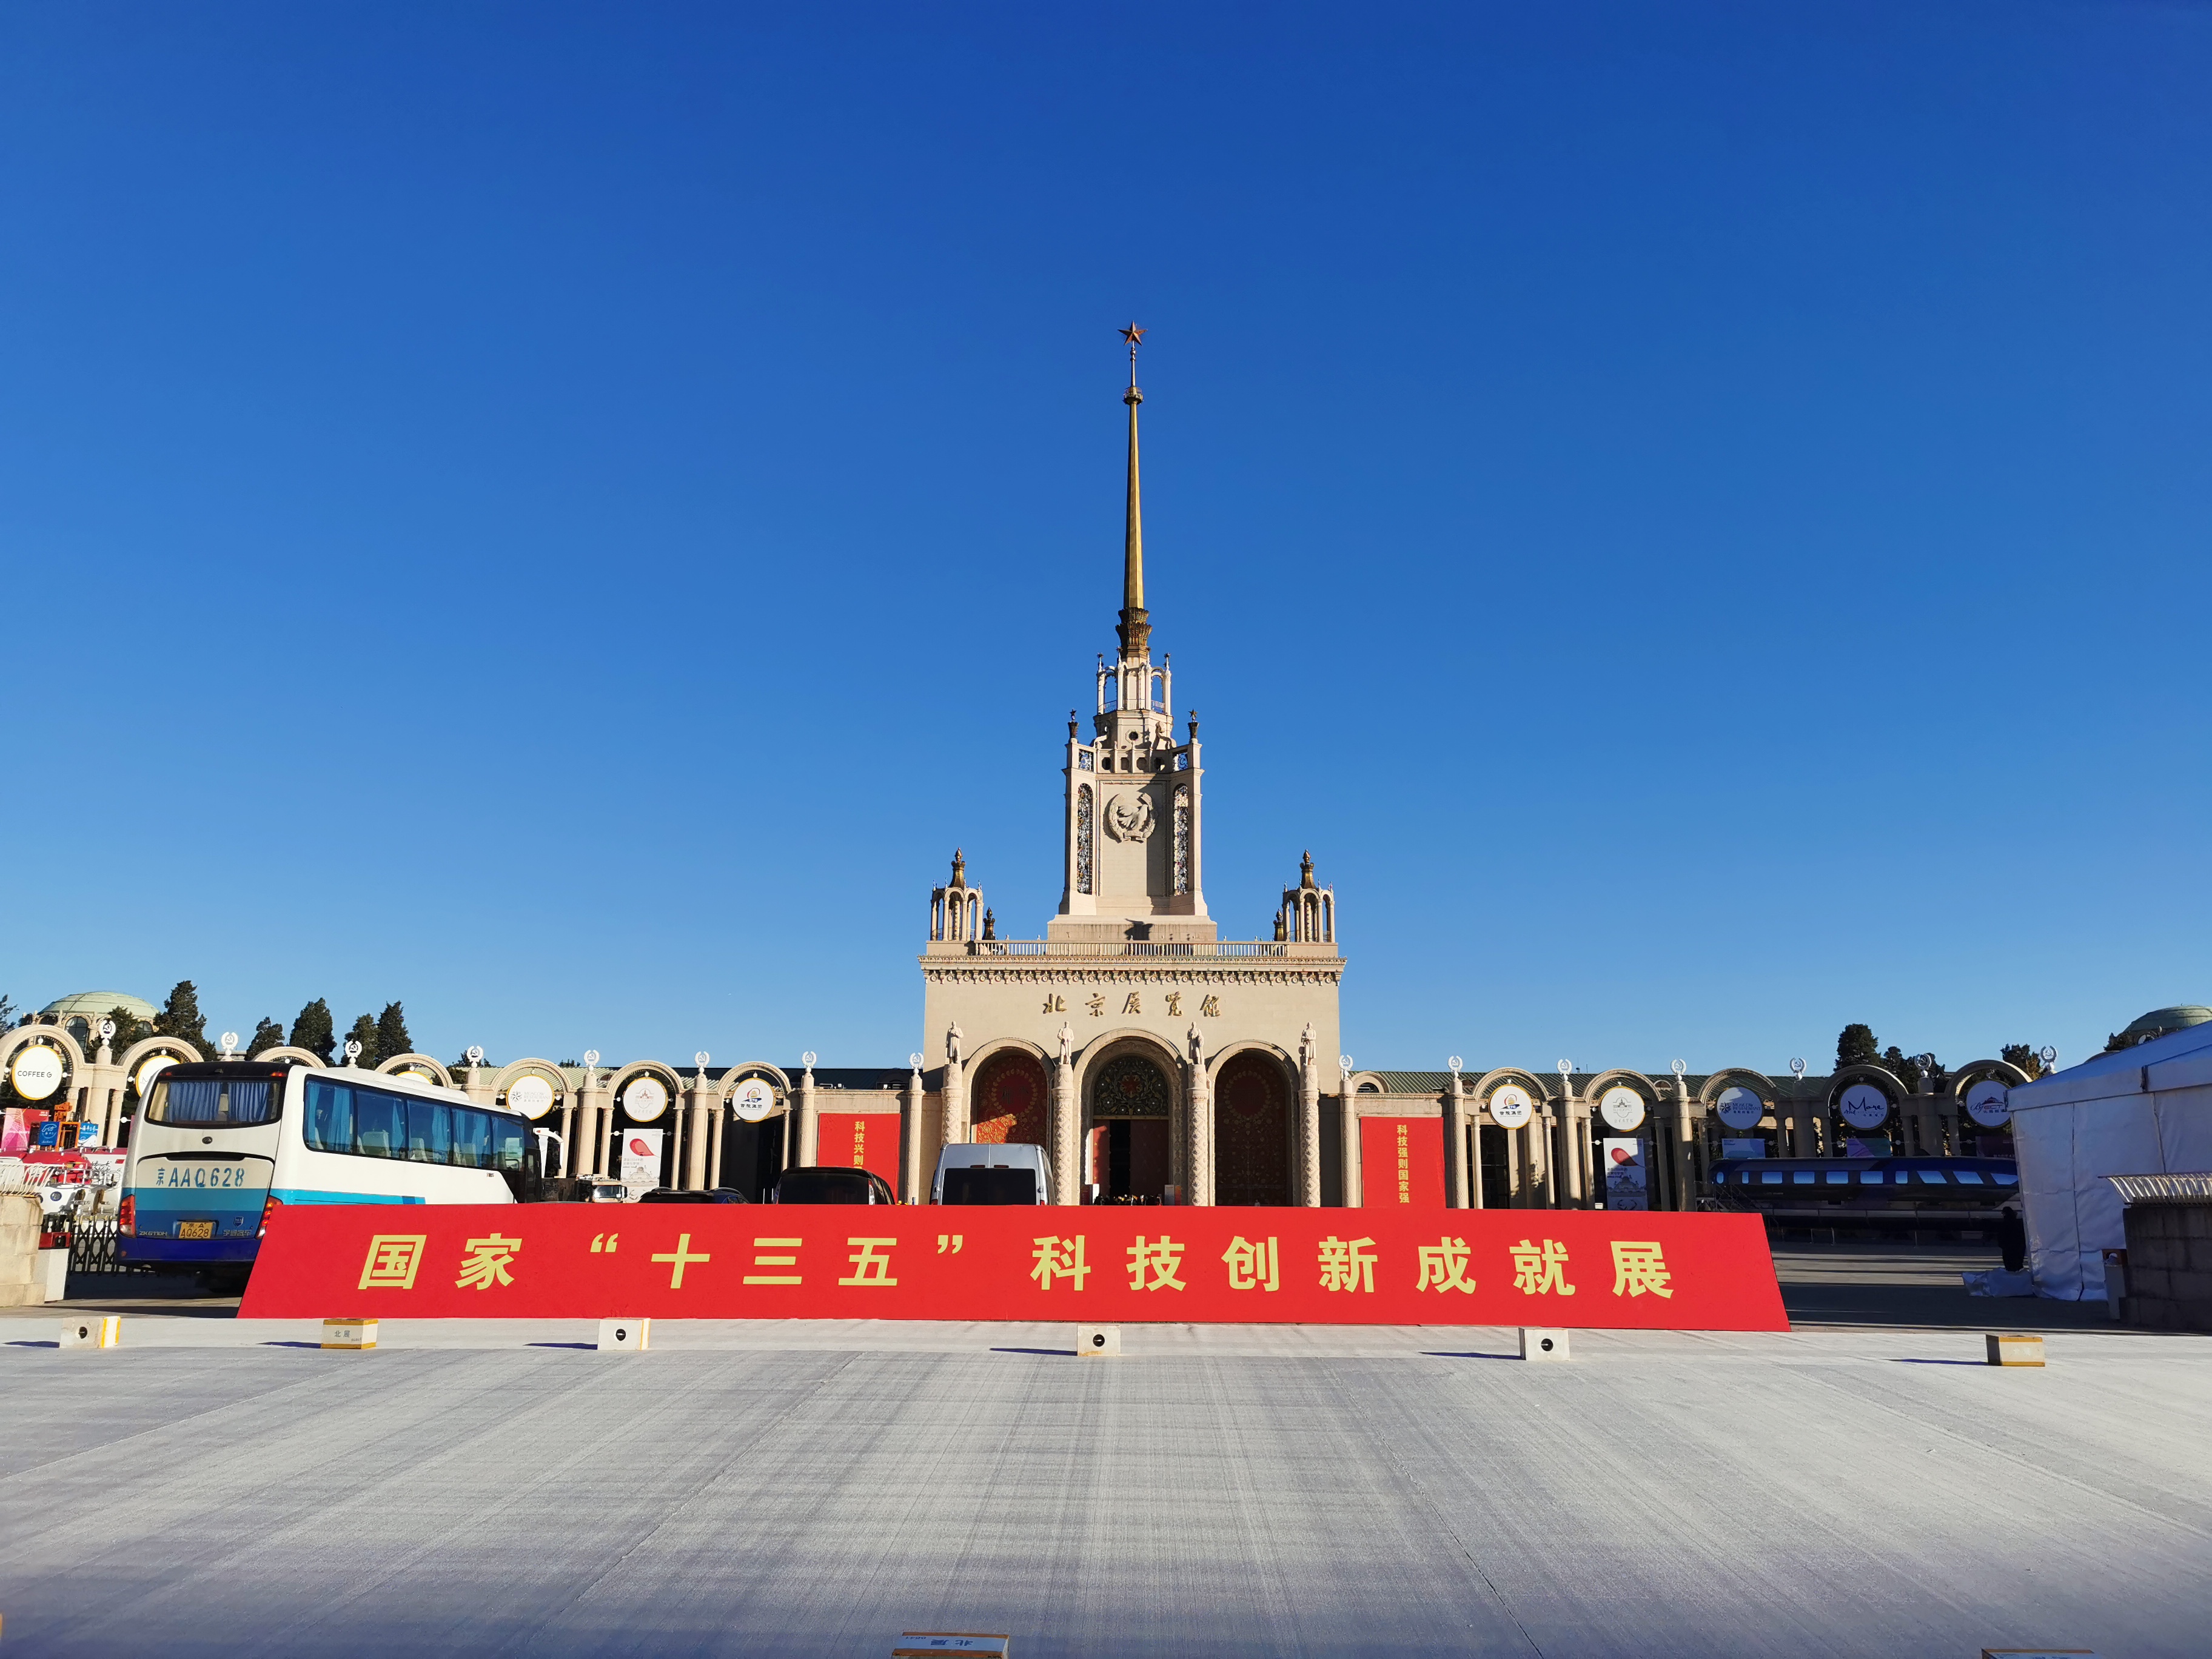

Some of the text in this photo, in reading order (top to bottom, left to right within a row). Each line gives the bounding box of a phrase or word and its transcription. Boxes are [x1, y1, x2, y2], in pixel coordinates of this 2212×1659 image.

[1042, 991, 1221, 1017] 北京展览馆
[853, 1121, 865, 1168] 科技兴则
[1397, 1124, 1410, 1203] 科技强则国家强
[156, 1167, 245, 1187] 京AAQ628
[180, 1228, 210, 1238] AQ628
